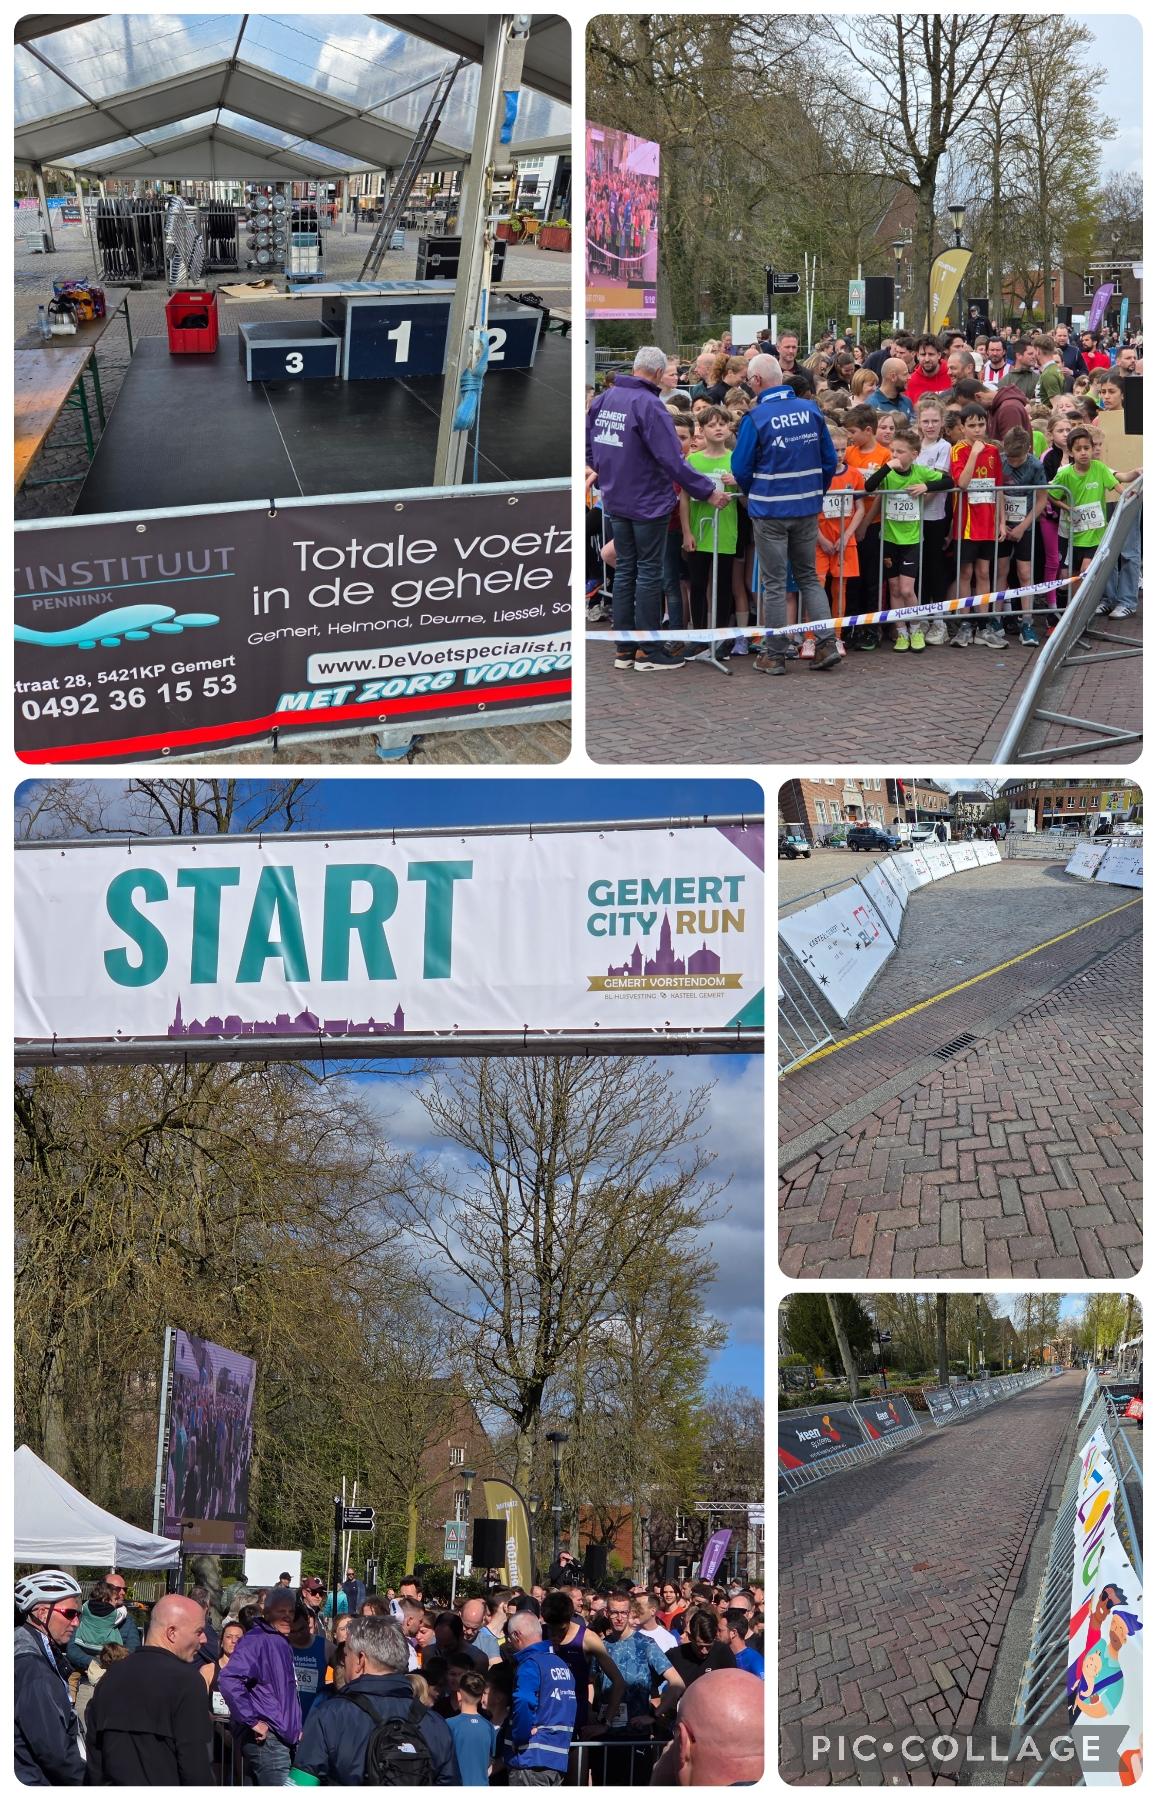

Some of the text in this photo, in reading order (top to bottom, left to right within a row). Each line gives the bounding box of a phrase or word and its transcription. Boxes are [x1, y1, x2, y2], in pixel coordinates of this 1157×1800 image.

[387, 321, 412, 363] 1
[488, 328, 507, 361] 2
[285, 352, 304, 374] 3
[595, 418, 625, 431] CITY RUN
[598, 410, 627, 422] GEMERT
[771, 410, 809, 429] CREW
[828, 498, 850, 507] 101
[893, 502, 914, 511] 1203
[292, 525, 571, 571] Totale voetz
[32, 592, 113, 612] PENNINX
[253, 586, 289, 615] in
[308, 577, 374, 608] de
[391, 564, 553, 608] gehele
[895, 601, 943, 618] Rabobank
[247, 624, 320, 645] Gemert,
[328, 616, 413, 635] Helmond,
[420, 612, 486, 627] Deurne,
[493, 604, 546, 622] Liessel,
[318, 638, 571, 675] www.DeVoetspecialist.n
[64, 673, 92, 688] 28,
[98, 664, 165, 684] 5421KP
[171, 655, 236, 675] Gemert
[22, 674, 237, 721] 0492 36 15 53
[276, 684, 355, 713] MET
[357, 671, 455, 702] ZORG
[588, 875, 745, 907] GEMERT
[104, 860, 473, 987] START
[587, 909, 745, 937] CITY RUN
[604, 976, 725, 988] GEMERT VORSTENDOM
[670, 991, 698, 999] KASTEEL
[698, 991, 725, 999] GEMERT
[551, 1667, 571, 1680] CREW
